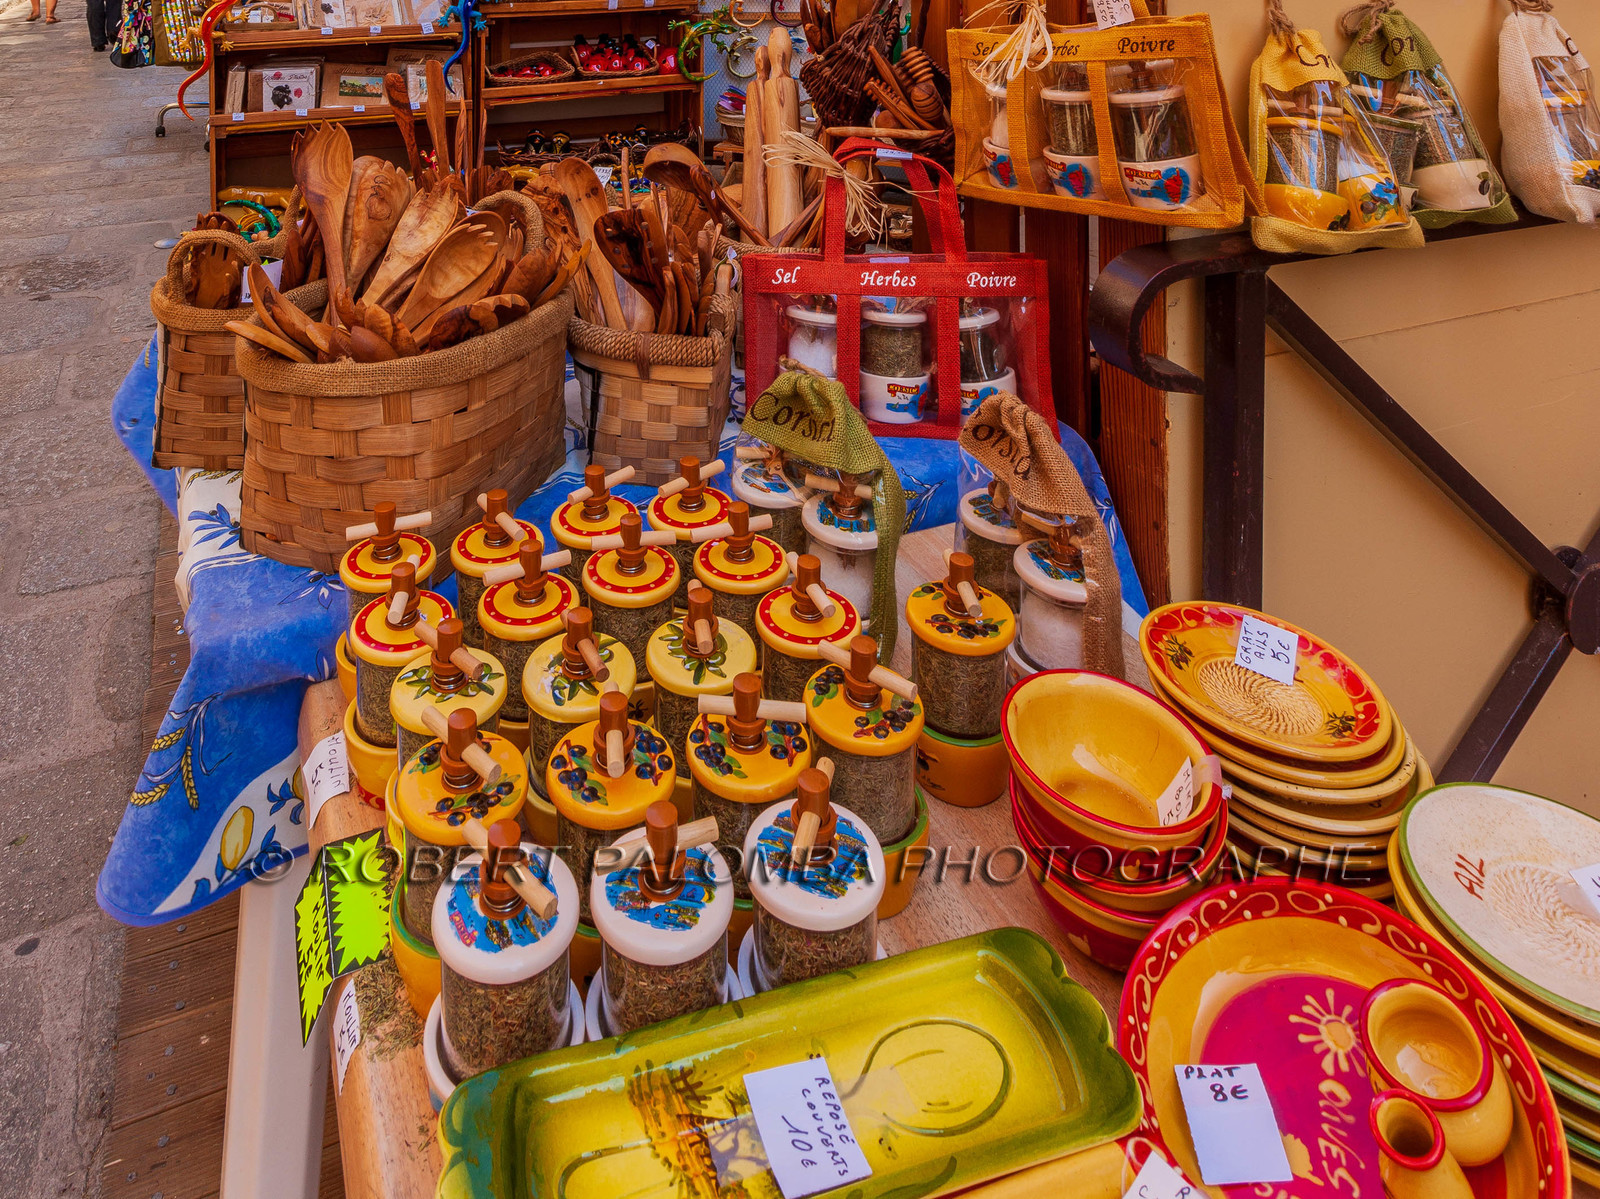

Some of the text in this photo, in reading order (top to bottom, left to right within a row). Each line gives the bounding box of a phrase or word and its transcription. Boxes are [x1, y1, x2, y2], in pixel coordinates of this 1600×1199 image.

[1117, 36, 1176, 54] Poivre
[771, 266, 1017, 289] Sel Herbes Poivre
[1453, 853, 1486, 901] AIL
[1184, 1065, 1241, 1080] PLAT
